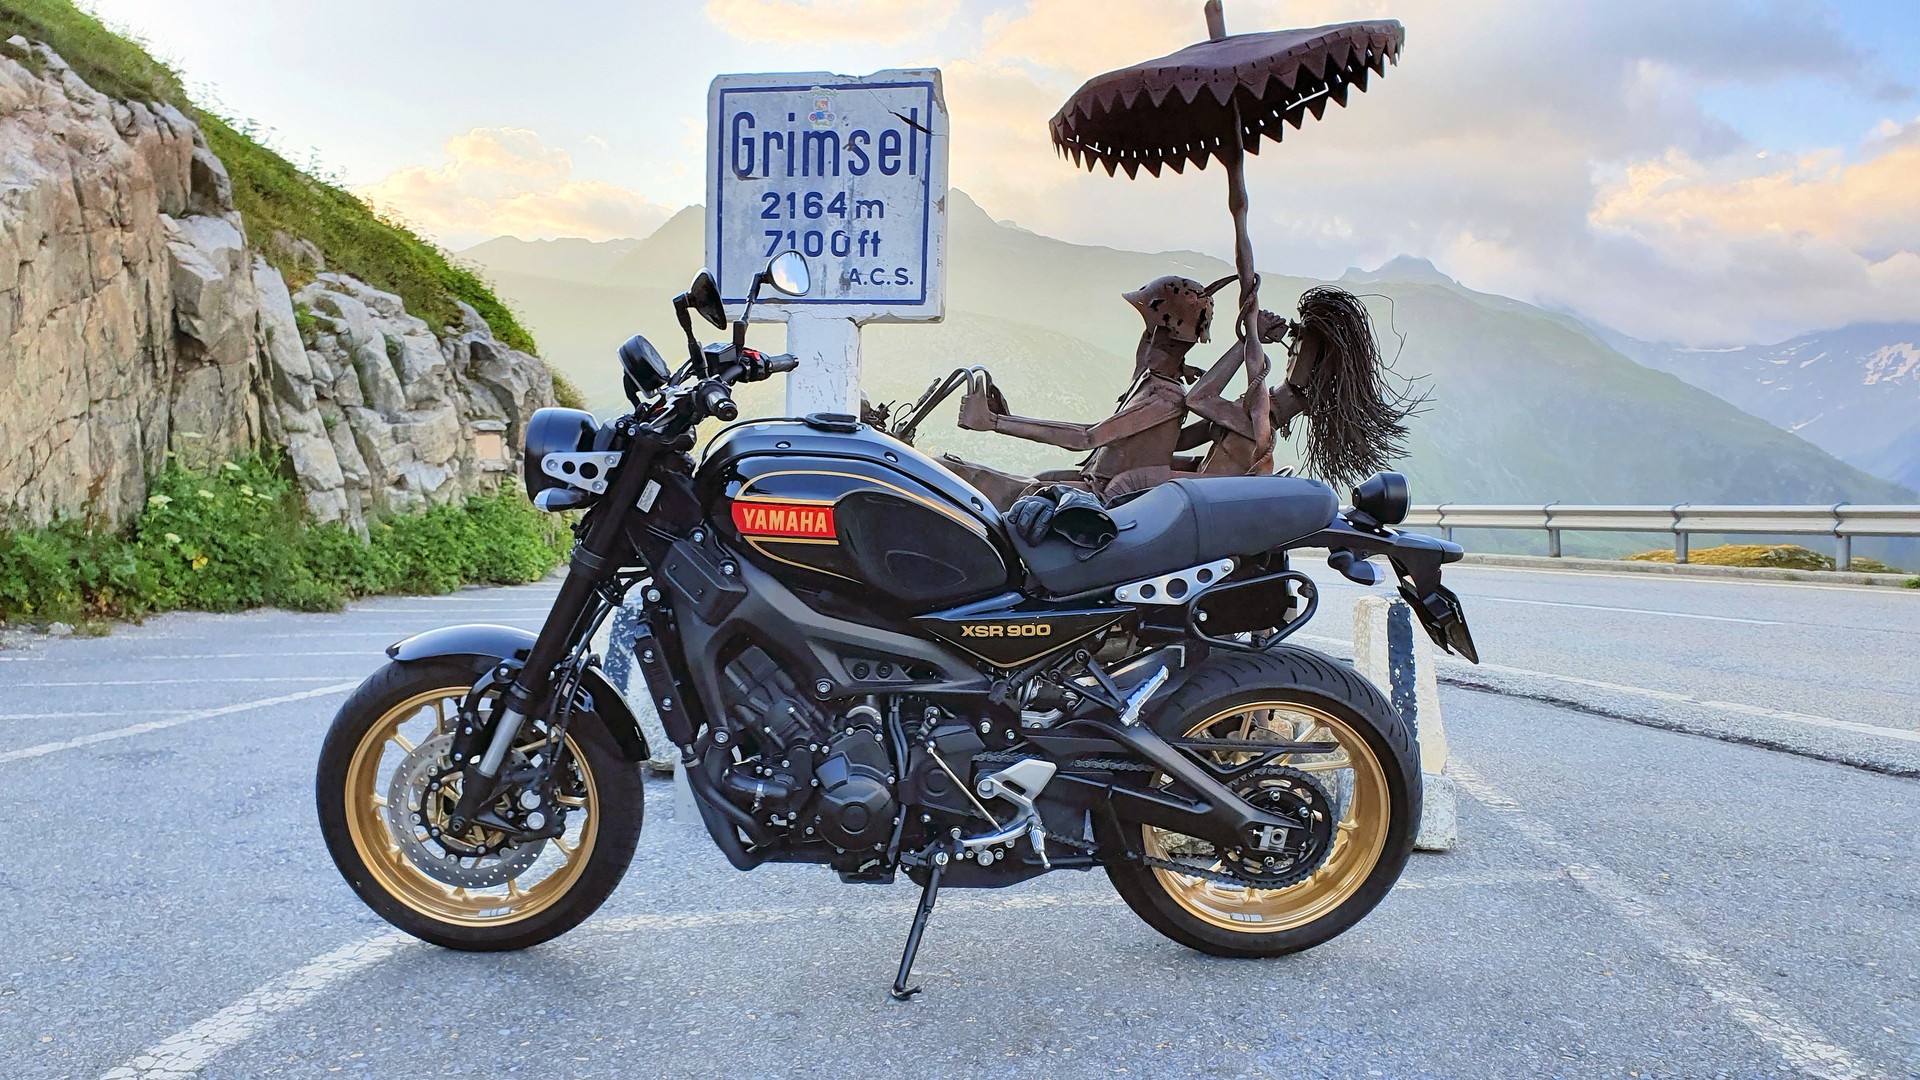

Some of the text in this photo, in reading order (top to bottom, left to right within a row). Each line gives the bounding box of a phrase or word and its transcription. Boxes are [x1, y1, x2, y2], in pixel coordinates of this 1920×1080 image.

[731, 107, 918, 178] Grimsel
[761, 191, 847, 219] 2164
[849, 267, 914, 286] A.C.S.
[742, 507, 828, 533] YAMAHA
[961, 624, 1051, 637] XSR 900
